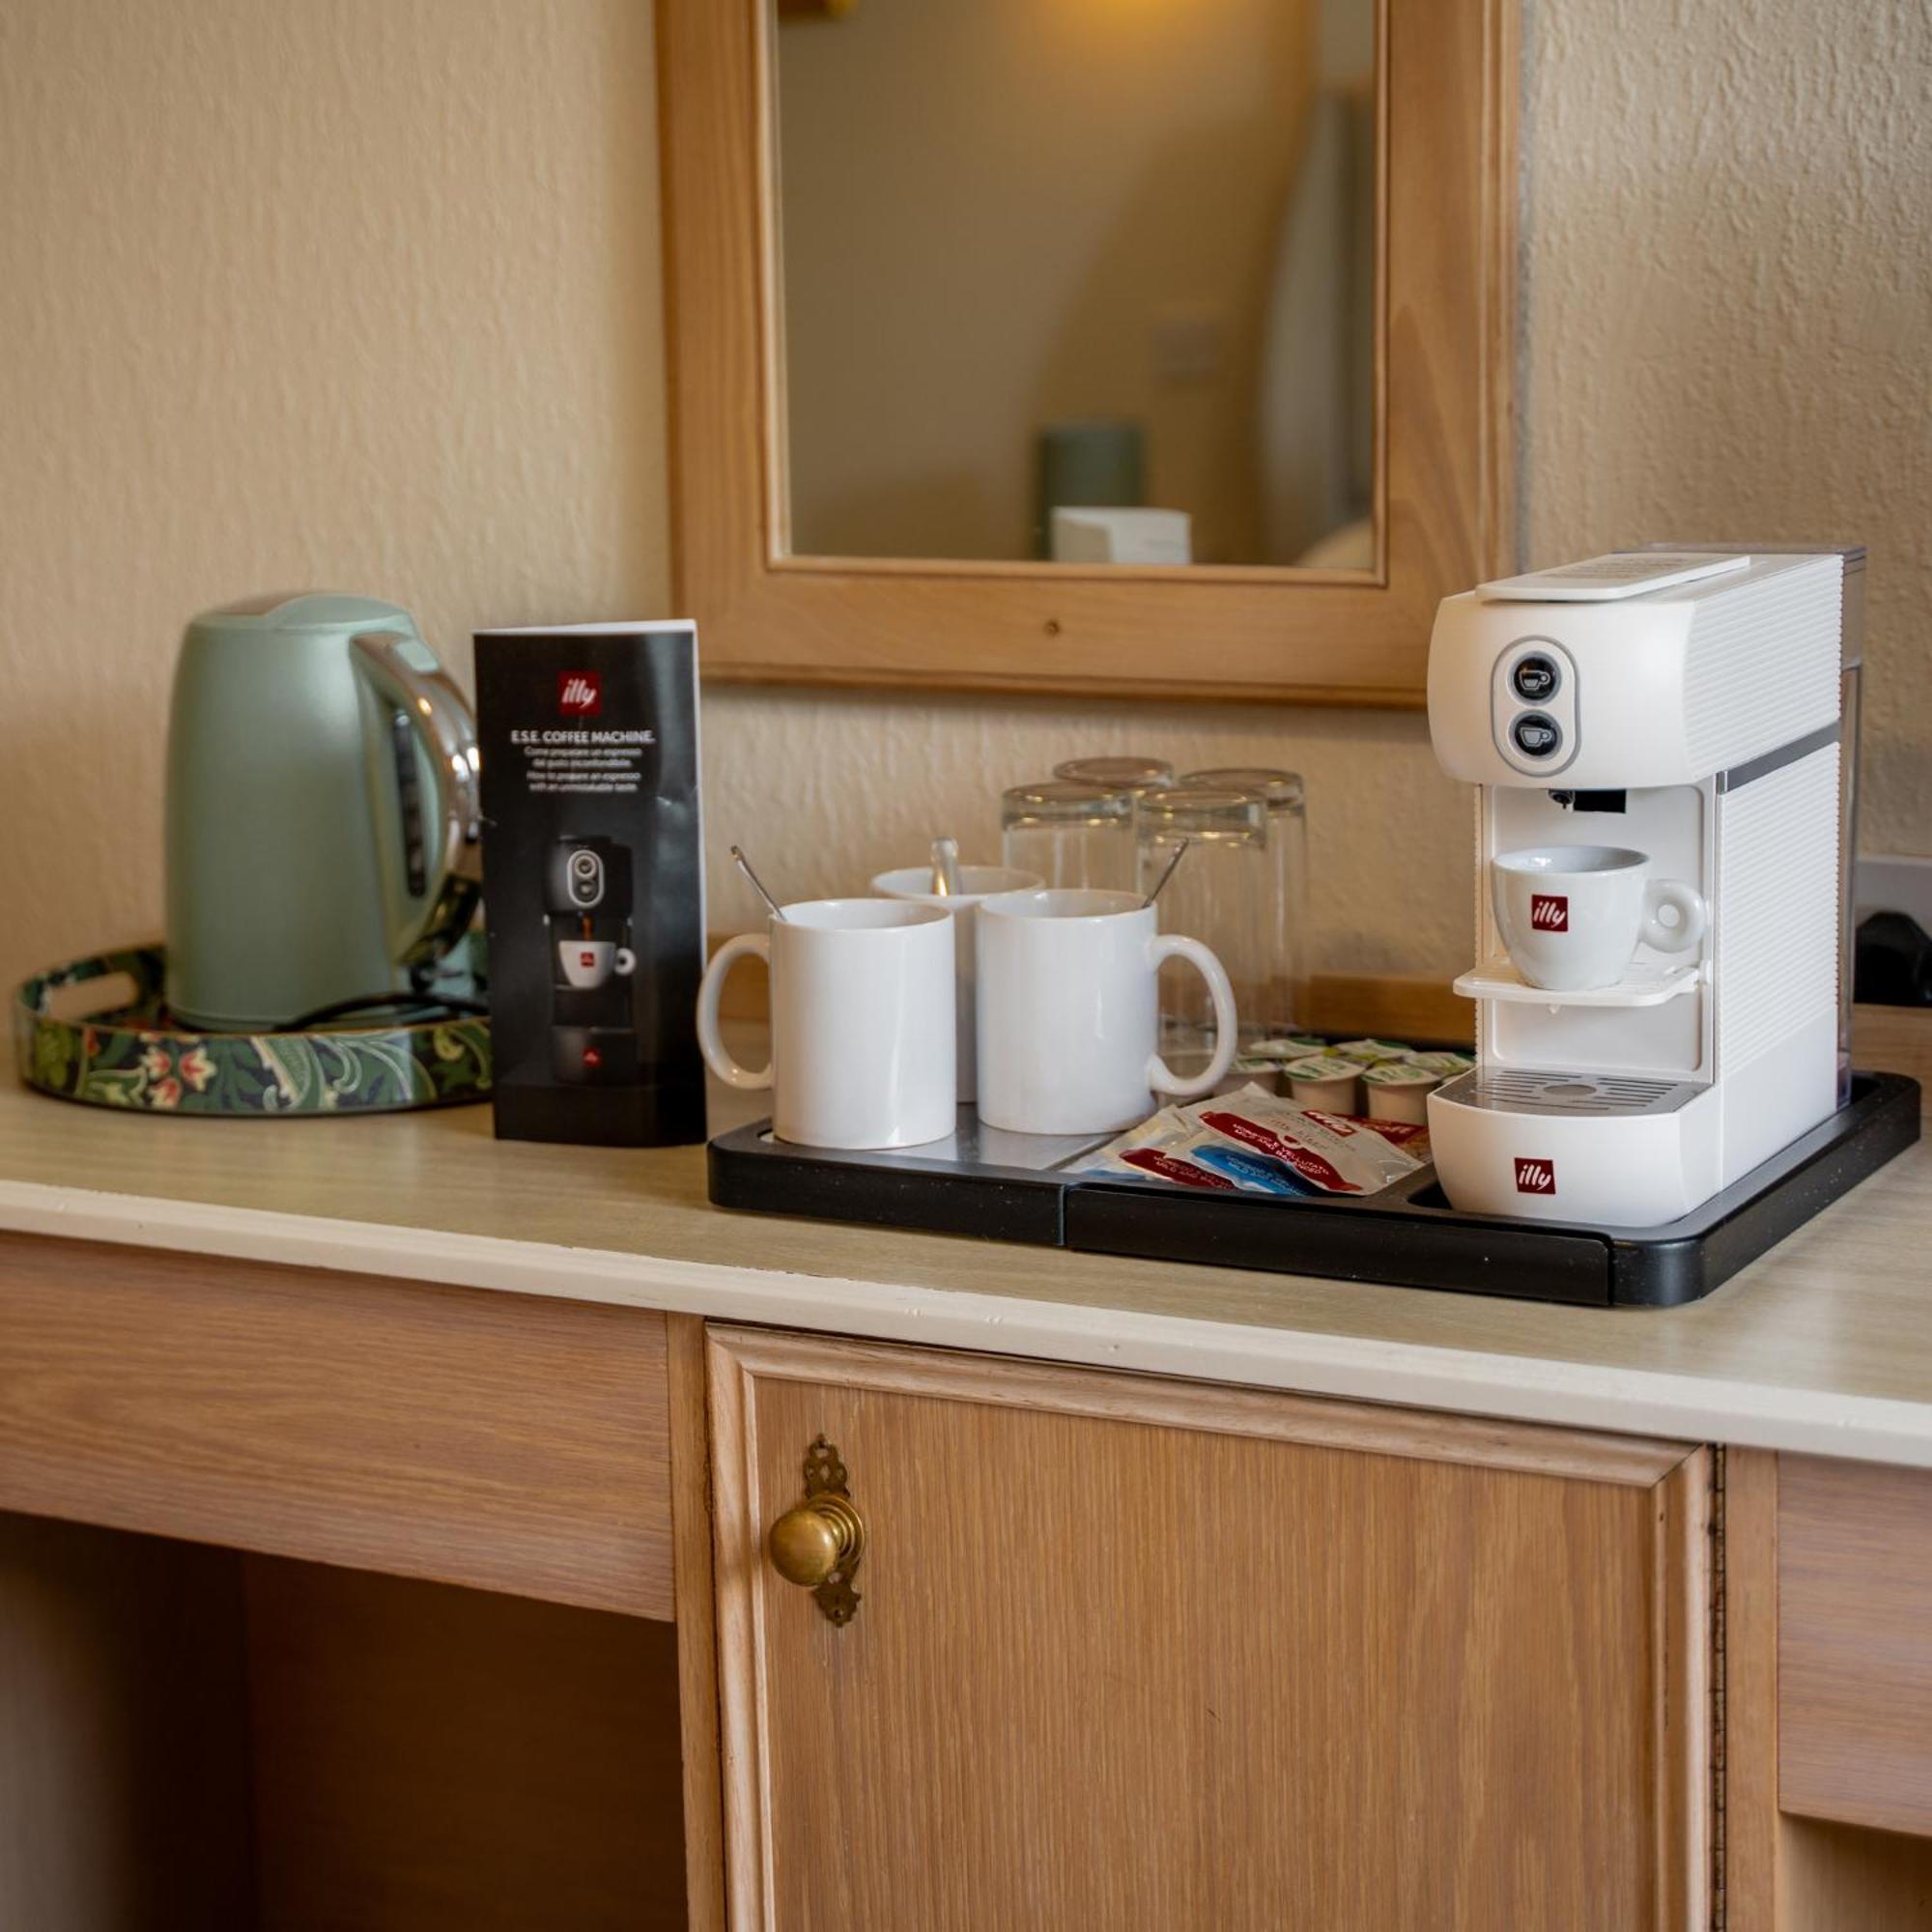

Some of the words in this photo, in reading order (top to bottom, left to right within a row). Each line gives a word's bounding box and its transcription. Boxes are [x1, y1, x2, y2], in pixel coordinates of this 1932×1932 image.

[561, 678, 597, 708] illy
[542, 730, 590, 744] COFFEE
[1534, 900, 1566, 928] illy
[1517, 1164, 1551, 1192] illy
